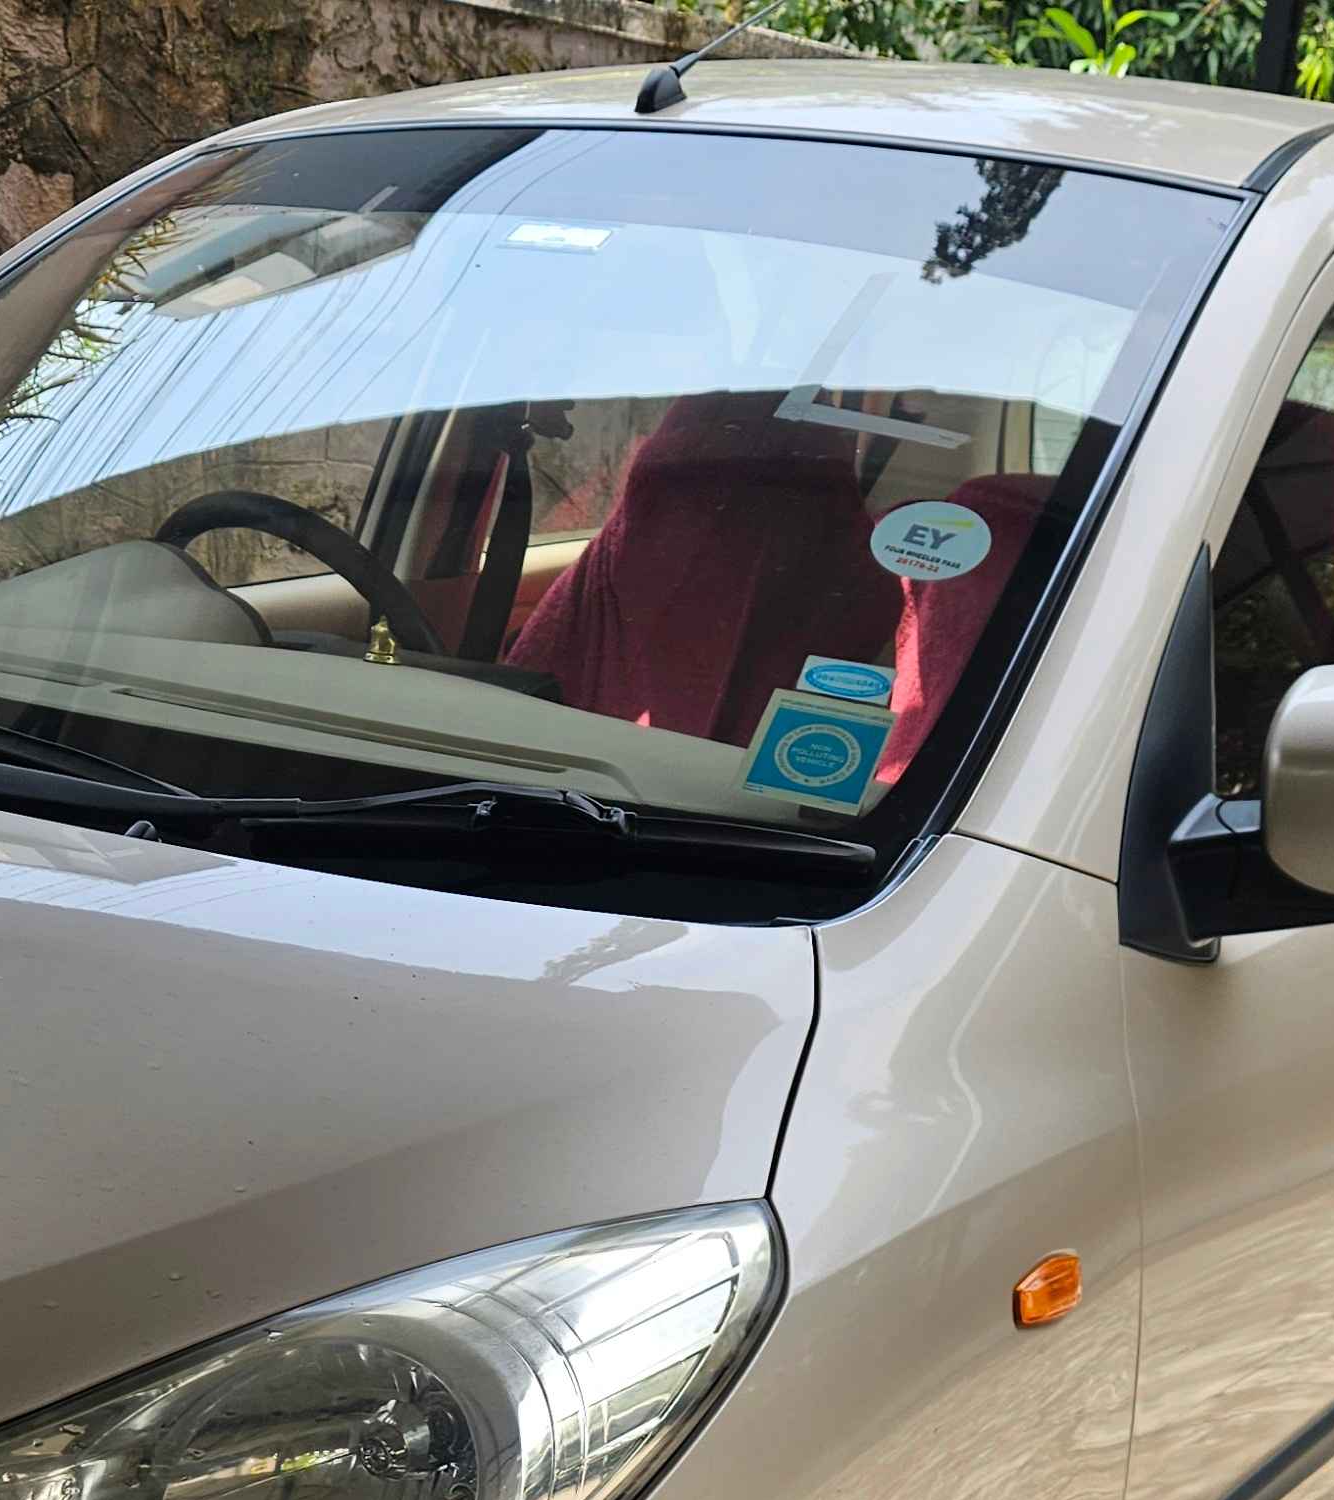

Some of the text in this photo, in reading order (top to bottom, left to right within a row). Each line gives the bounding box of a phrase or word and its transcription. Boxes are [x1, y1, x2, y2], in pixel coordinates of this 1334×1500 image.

[903, 524, 957, 550] EY
[884, 545, 904, 554] FOUR
[906, 551, 940, 563] WHEELER
[791, 748, 844, 763] POLLUTING
[812, 744, 832, 752] NON
[795, 756, 836, 768] VEHICLE
